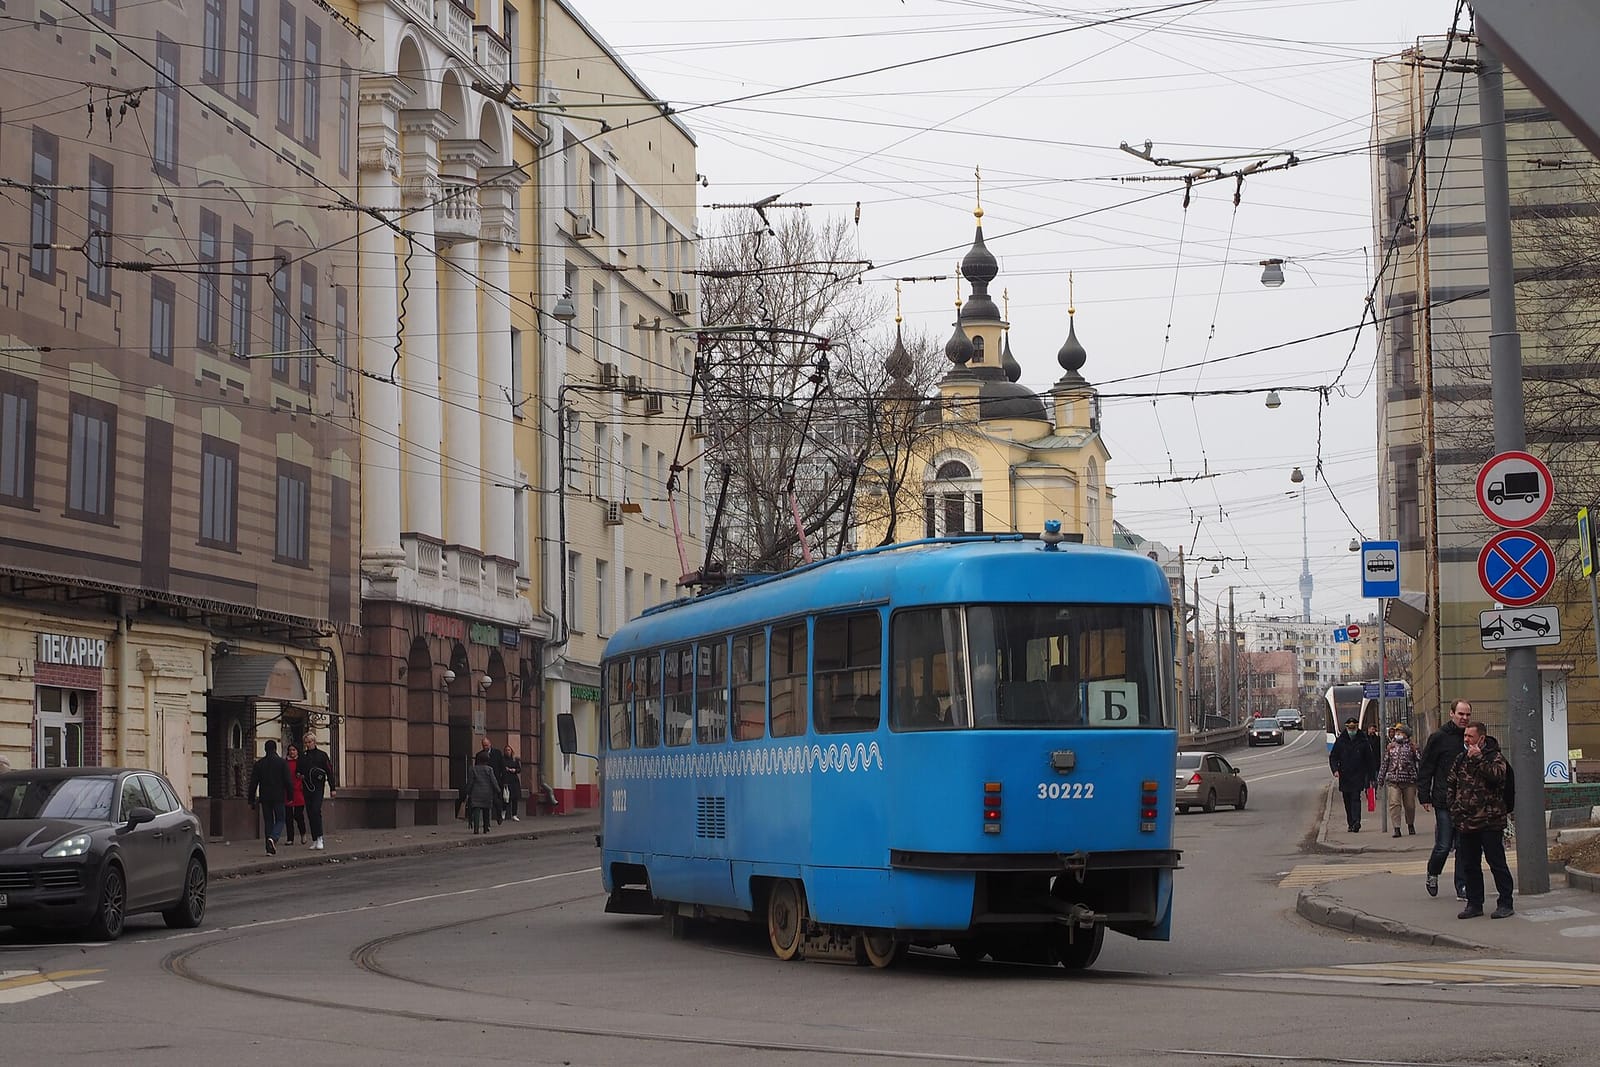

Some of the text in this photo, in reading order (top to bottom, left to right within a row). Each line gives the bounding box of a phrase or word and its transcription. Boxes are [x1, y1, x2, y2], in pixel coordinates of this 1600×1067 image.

[42, 634, 105, 667] ПЕКАРНЯ
[1101, 690, 1128, 721] Б
[1037, 783, 1095, 799] 30222
